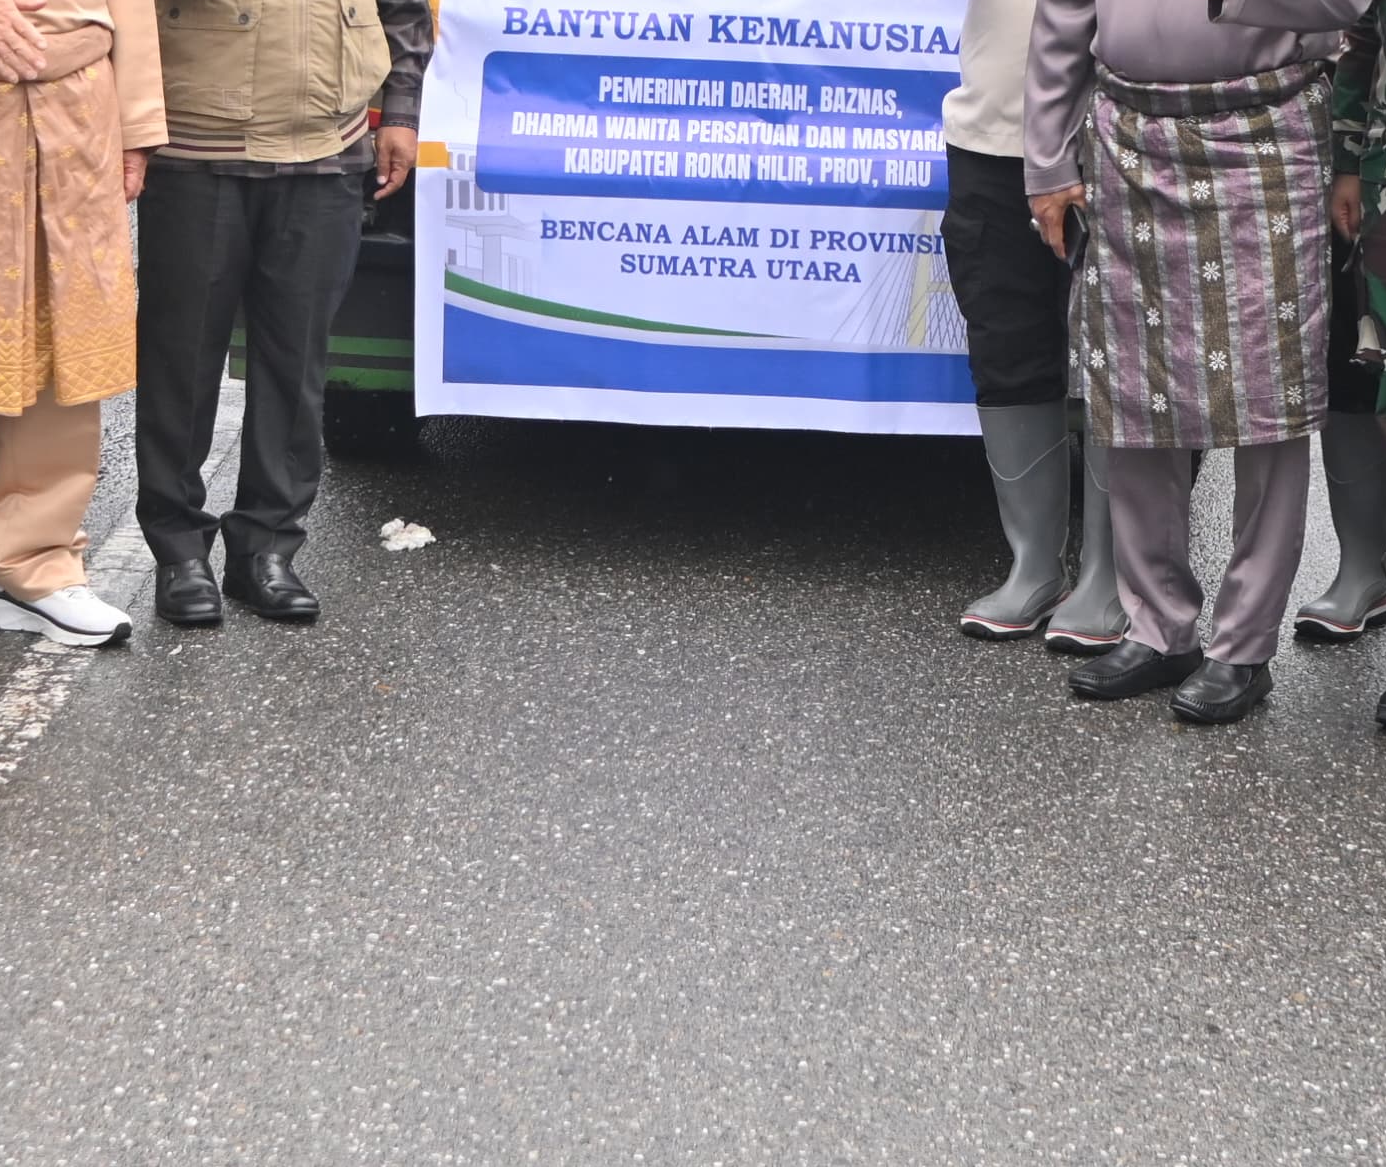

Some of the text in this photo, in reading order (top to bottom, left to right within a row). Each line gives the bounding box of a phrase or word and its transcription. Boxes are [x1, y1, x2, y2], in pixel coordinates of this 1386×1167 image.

[502, 6, 695, 43] BANTUAN
[599, 75, 903, 120] PEMERINTAH DAERAH, BAZNAS,
[512, 111, 947, 152] DHARMA WANITA PERSATUAN DAN MASYARA
[564, 147, 932, 188] KABUPATEN ROKAN HILIR, PROV, RIAU
[539, 219, 944, 256] BENCANA ALAM DI PROVINSI
[620, 253, 862, 284] SUMATRA UTARA
